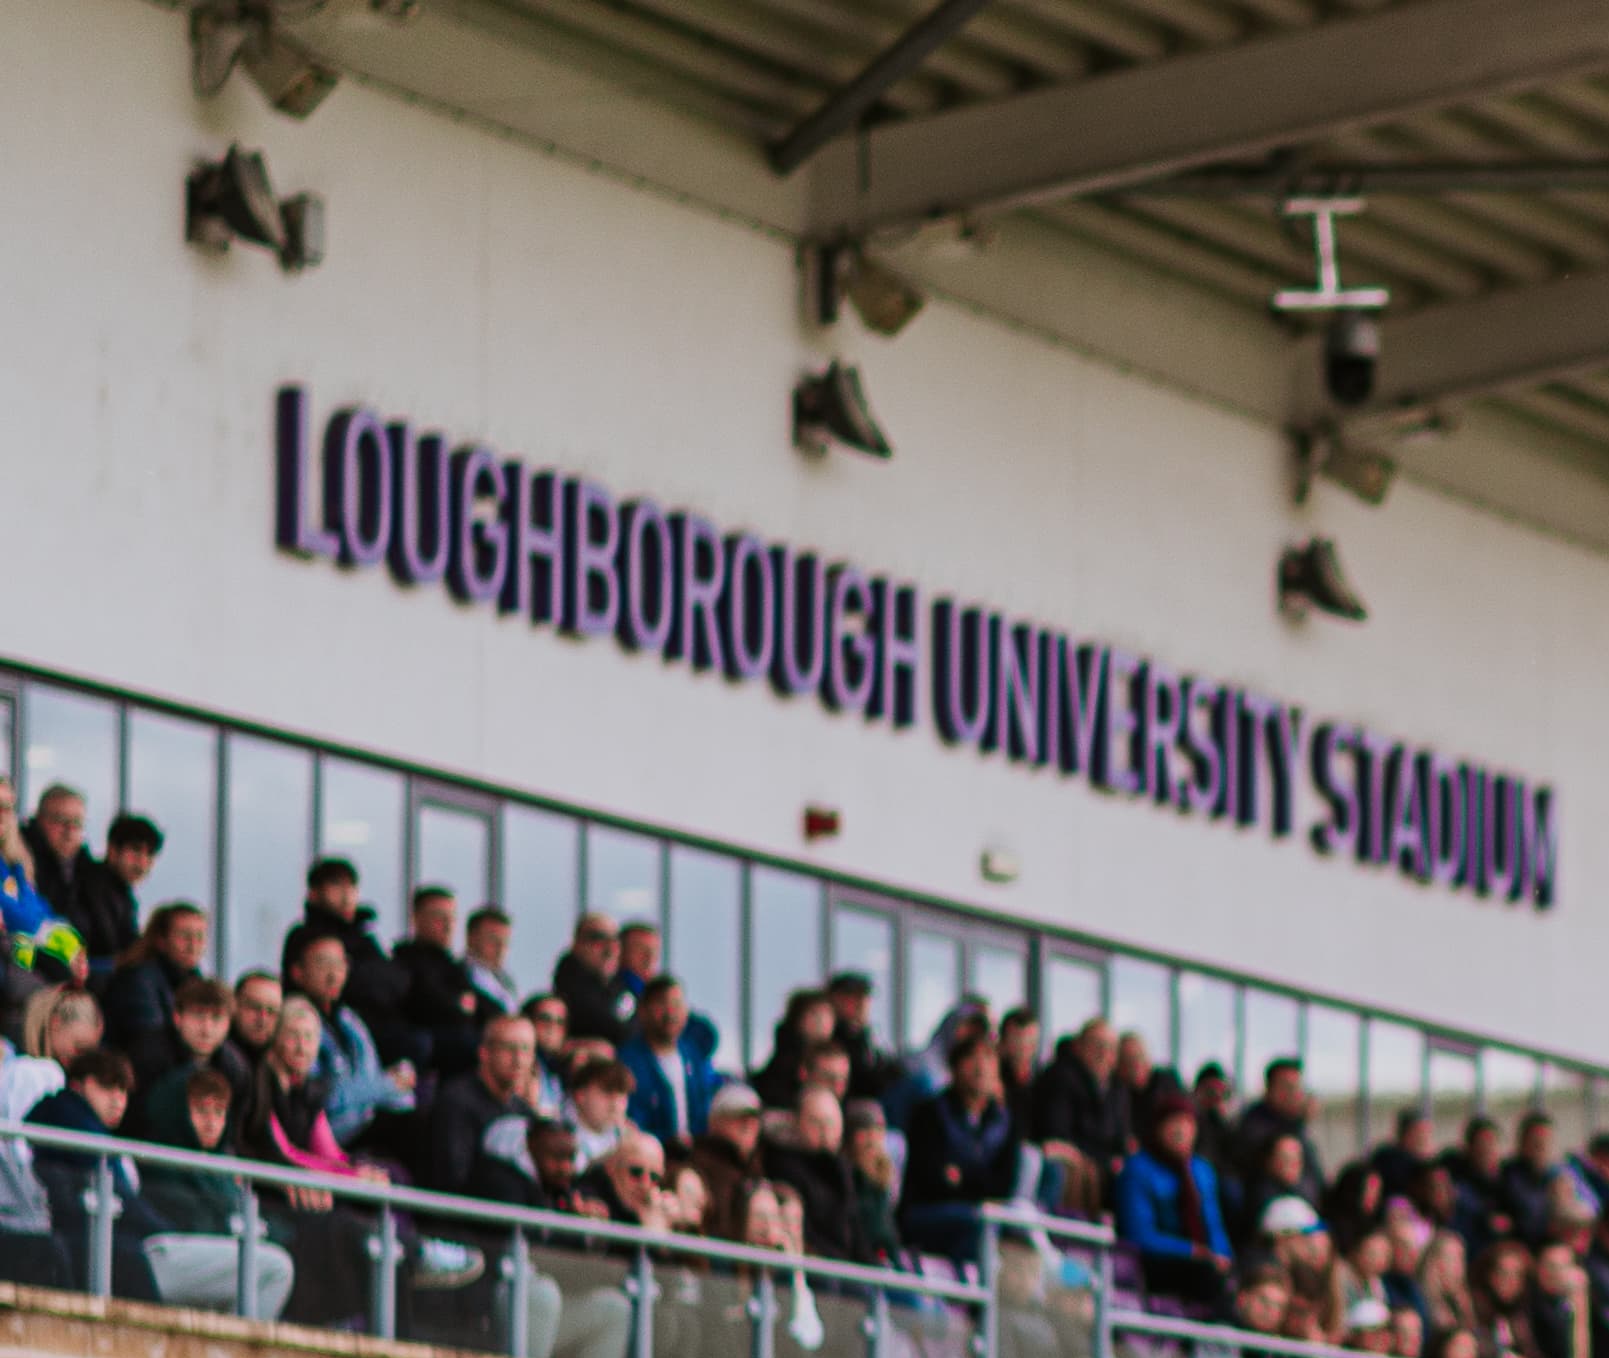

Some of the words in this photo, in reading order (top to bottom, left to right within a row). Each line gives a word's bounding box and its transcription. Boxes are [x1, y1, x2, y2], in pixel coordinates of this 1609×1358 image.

[274, 384, 920, 728] LOUGHBOROUGH
[931, 597, 1303, 838] UNIVERSITY
[1307, 722, 1559, 912] STADIUM
